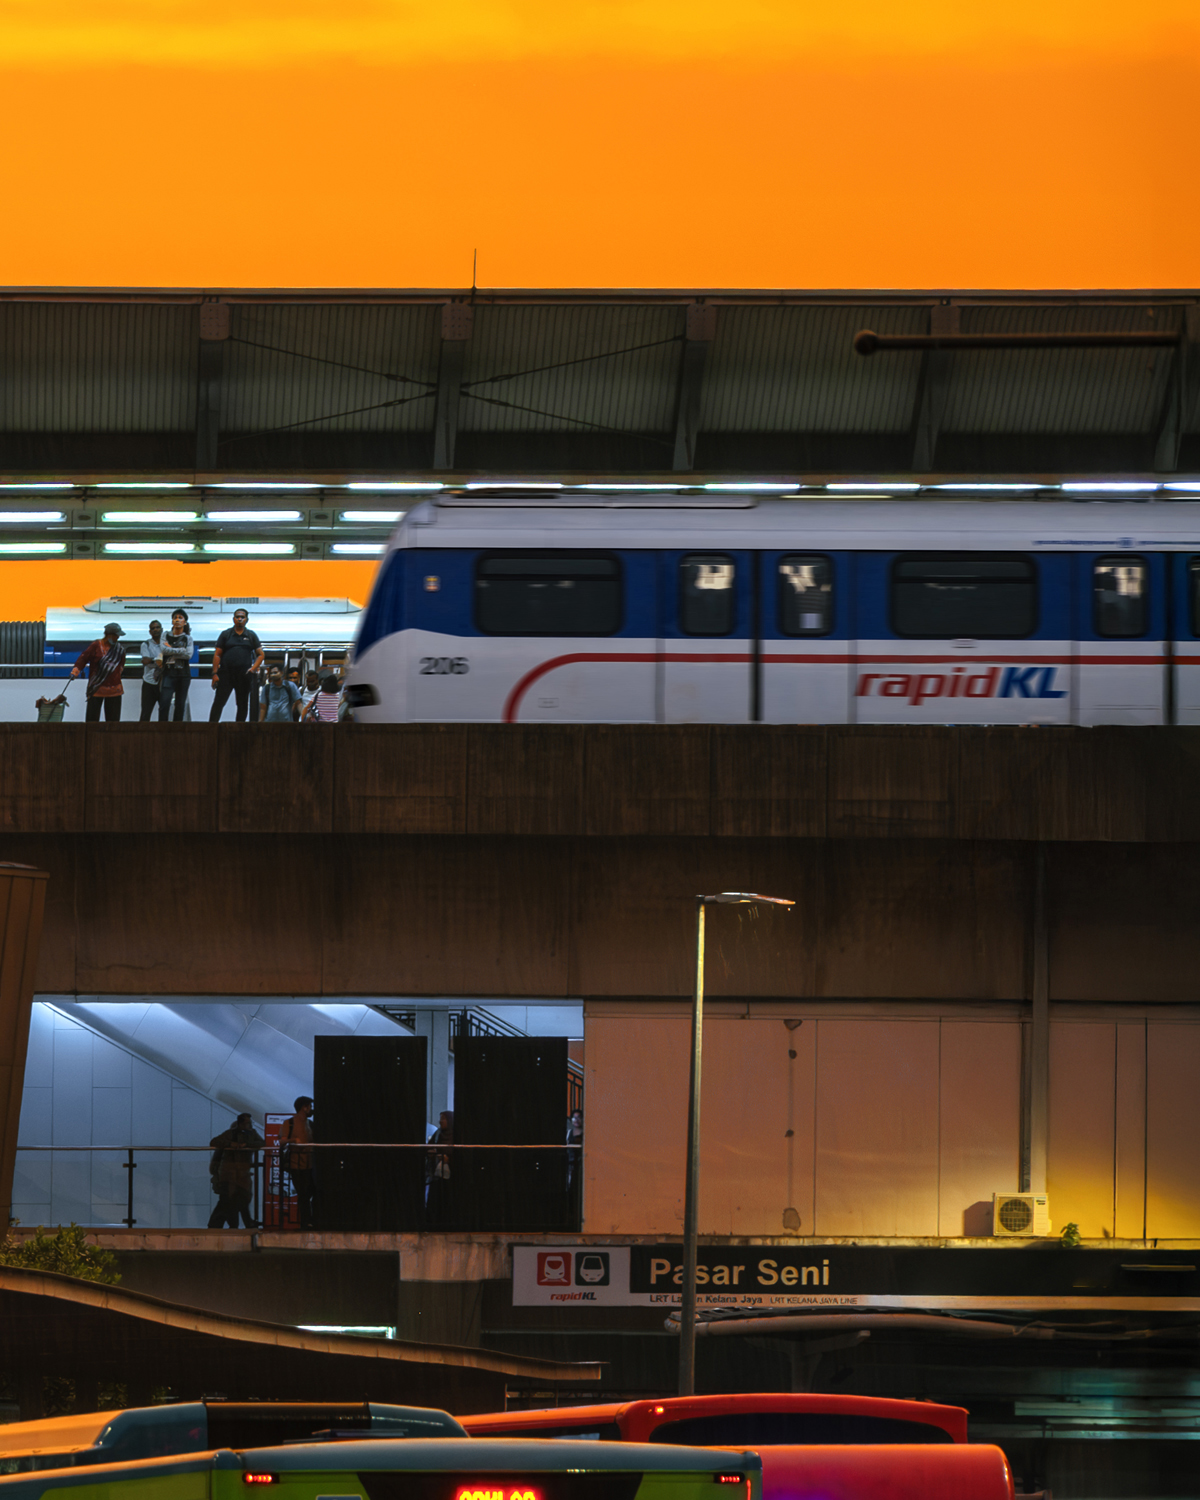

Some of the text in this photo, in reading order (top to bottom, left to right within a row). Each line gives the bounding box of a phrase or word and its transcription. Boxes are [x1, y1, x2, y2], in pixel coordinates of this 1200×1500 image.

[418, 656, 470, 675] 206
[853, 666, 1069, 707] rapidKL
[649, 1258, 831, 1286] Pasar Seni
[550, 1291, 598, 1302] rapidKL
[649, 1294, 669, 1303] LRT
[671, 1294, 703, 1303] Lan
[705, 1295, 738, 1304] Kelana
[740, 1295, 764, 1306] Jaya
[819, 1297, 839, 1305] JAYA
[839, 1297, 858, 1305] LINE
